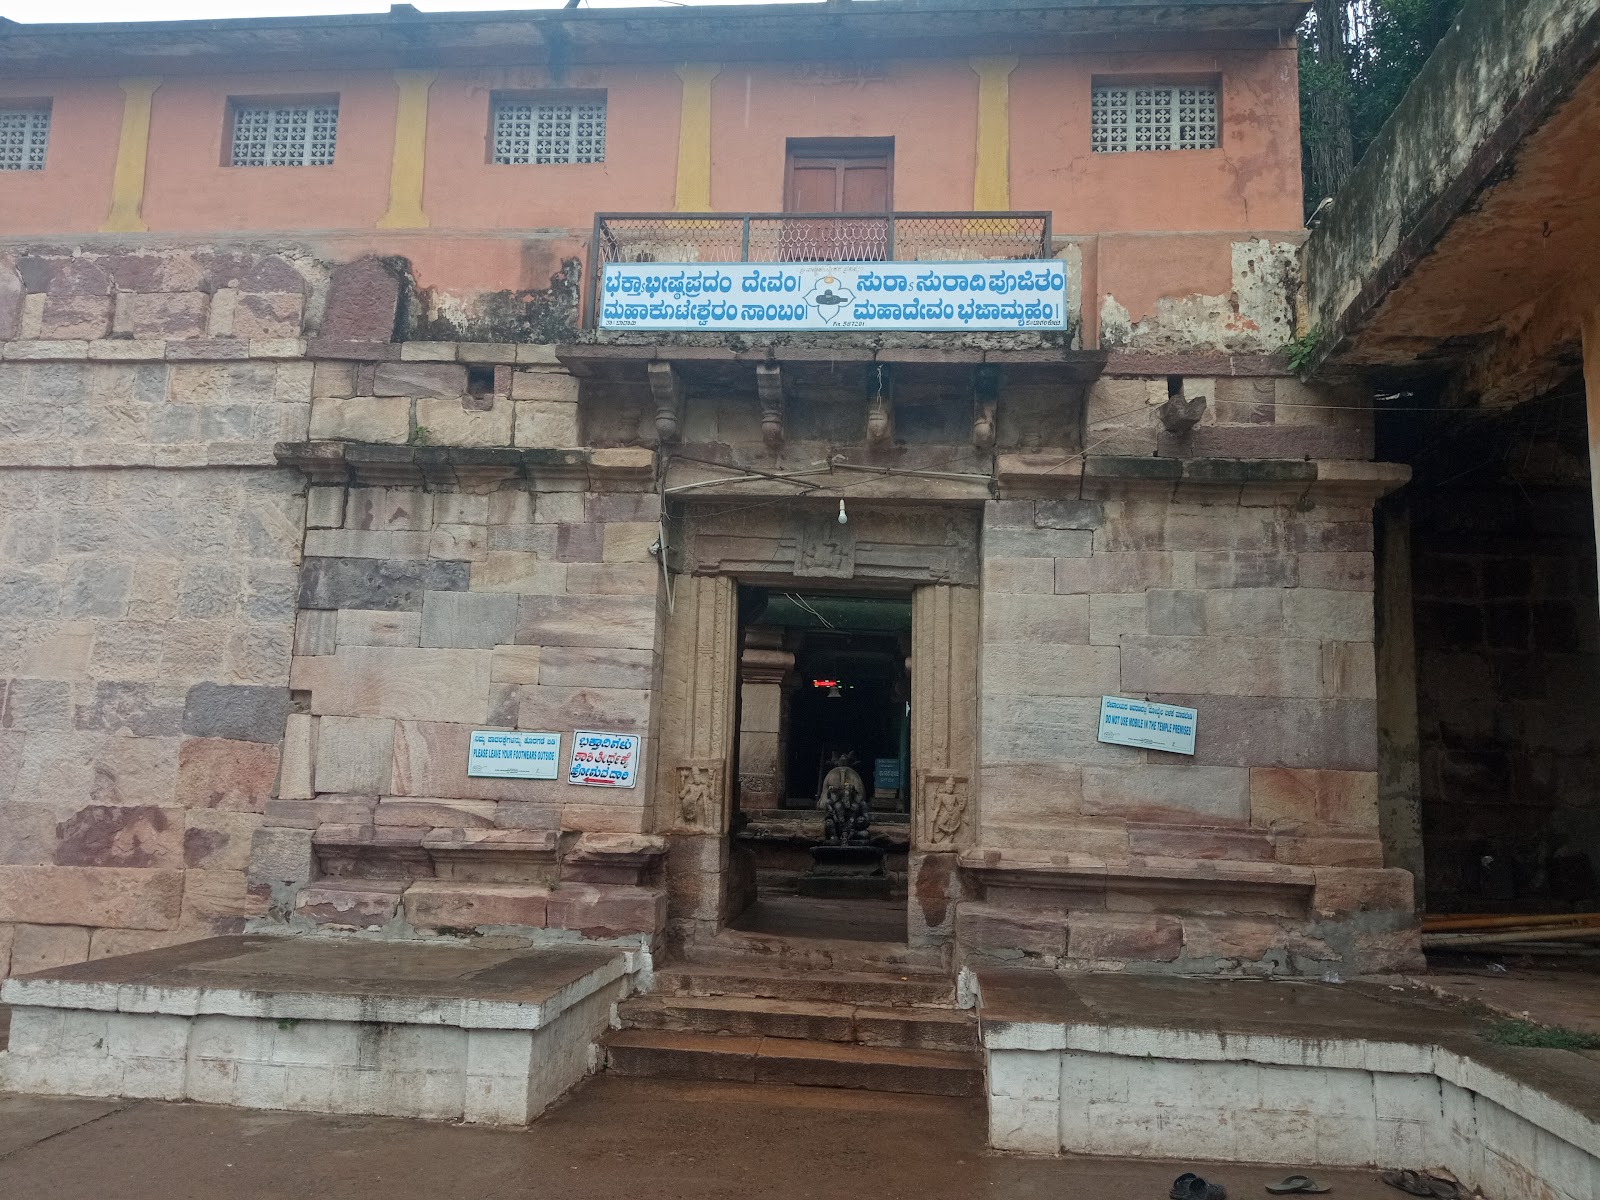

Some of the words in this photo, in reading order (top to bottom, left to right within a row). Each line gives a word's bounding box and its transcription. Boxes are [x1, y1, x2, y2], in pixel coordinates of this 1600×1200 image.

[1105, 714, 1112, 724] DO
[1111, 715, 1120, 725] NOT
[1120, 716, 1129, 727] USE
[1129, 717, 1144, 728] MOBILE
[1149, 720, 1157, 730] THE
[1157, 721, 1172, 733] TEMPLE
[473, 749, 488, 759] PLEASE
[488, 749, 501, 759] LEAVE
[501, 749, 513, 759] YOUR
[513, 750, 537, 760] FOOTWEARS
[537, 751, 555, 761] OUTSIDE
